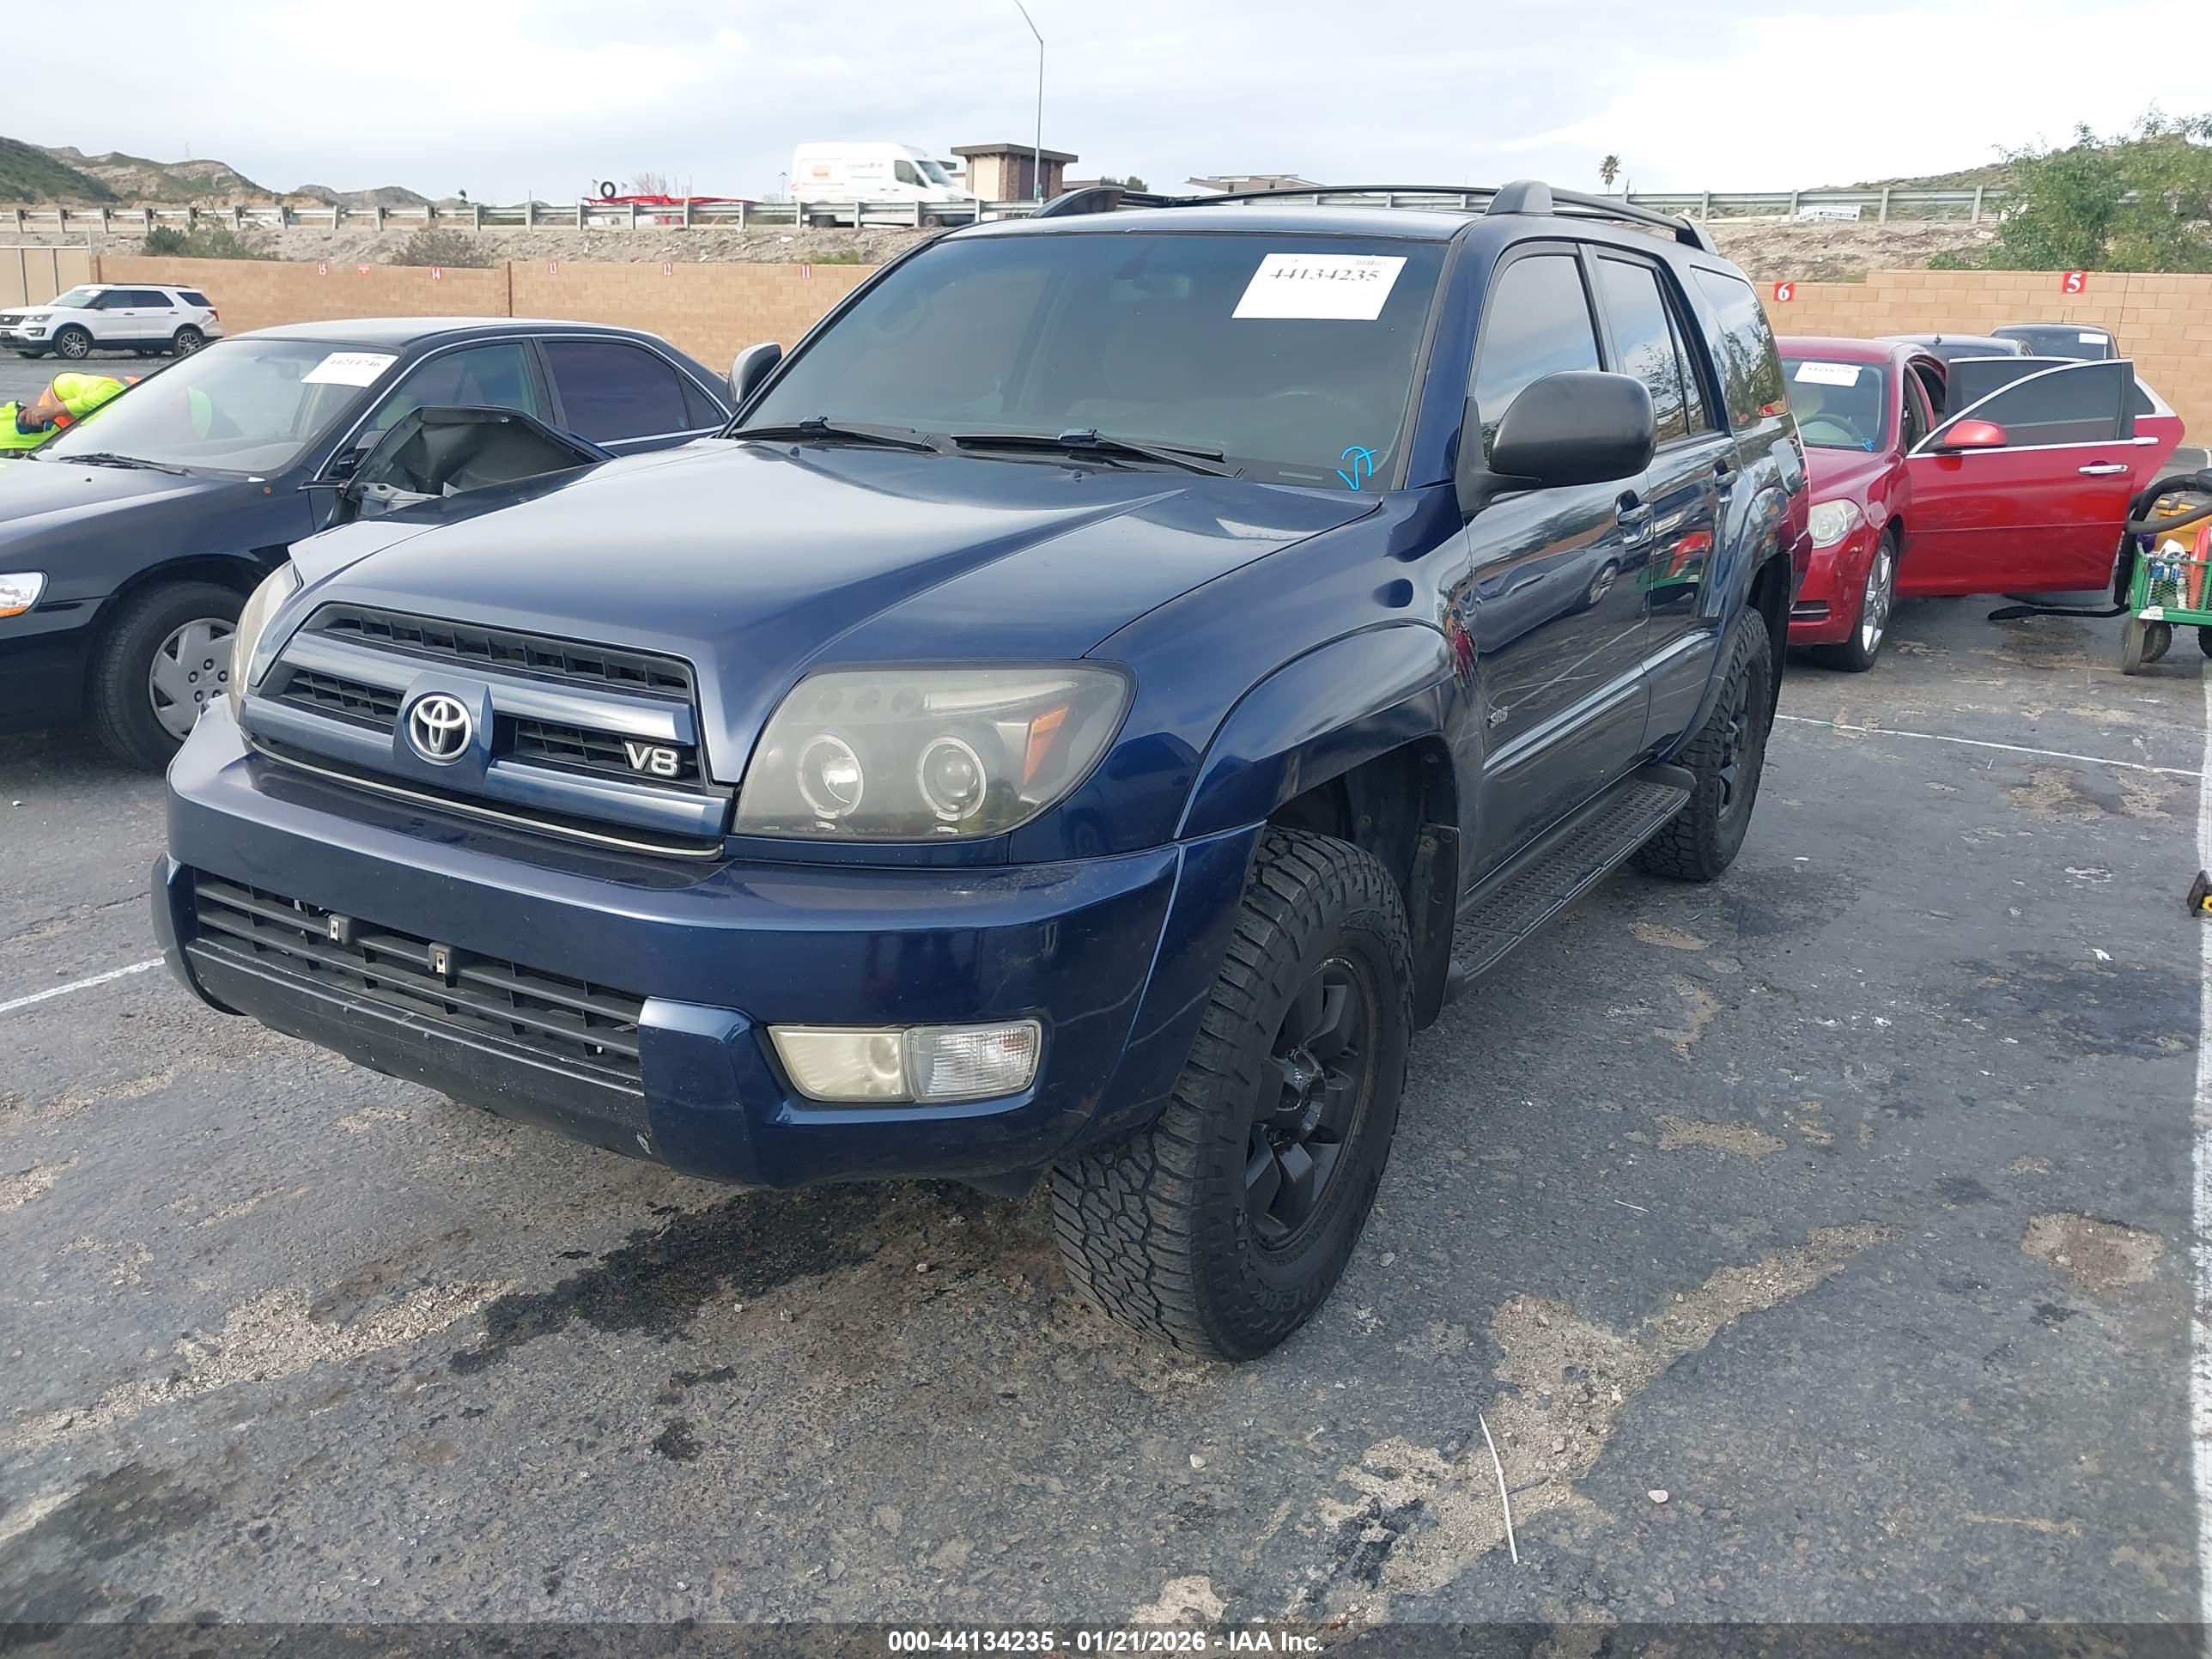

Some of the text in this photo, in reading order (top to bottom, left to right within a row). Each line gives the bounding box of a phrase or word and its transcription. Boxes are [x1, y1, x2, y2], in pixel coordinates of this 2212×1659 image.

[1270, 268, 1381, 281] 44134235
[2066, 273, 2082, 293] 5
[1778, 283, 1790, 301] 6
[625, 741, 678, 776] V8
